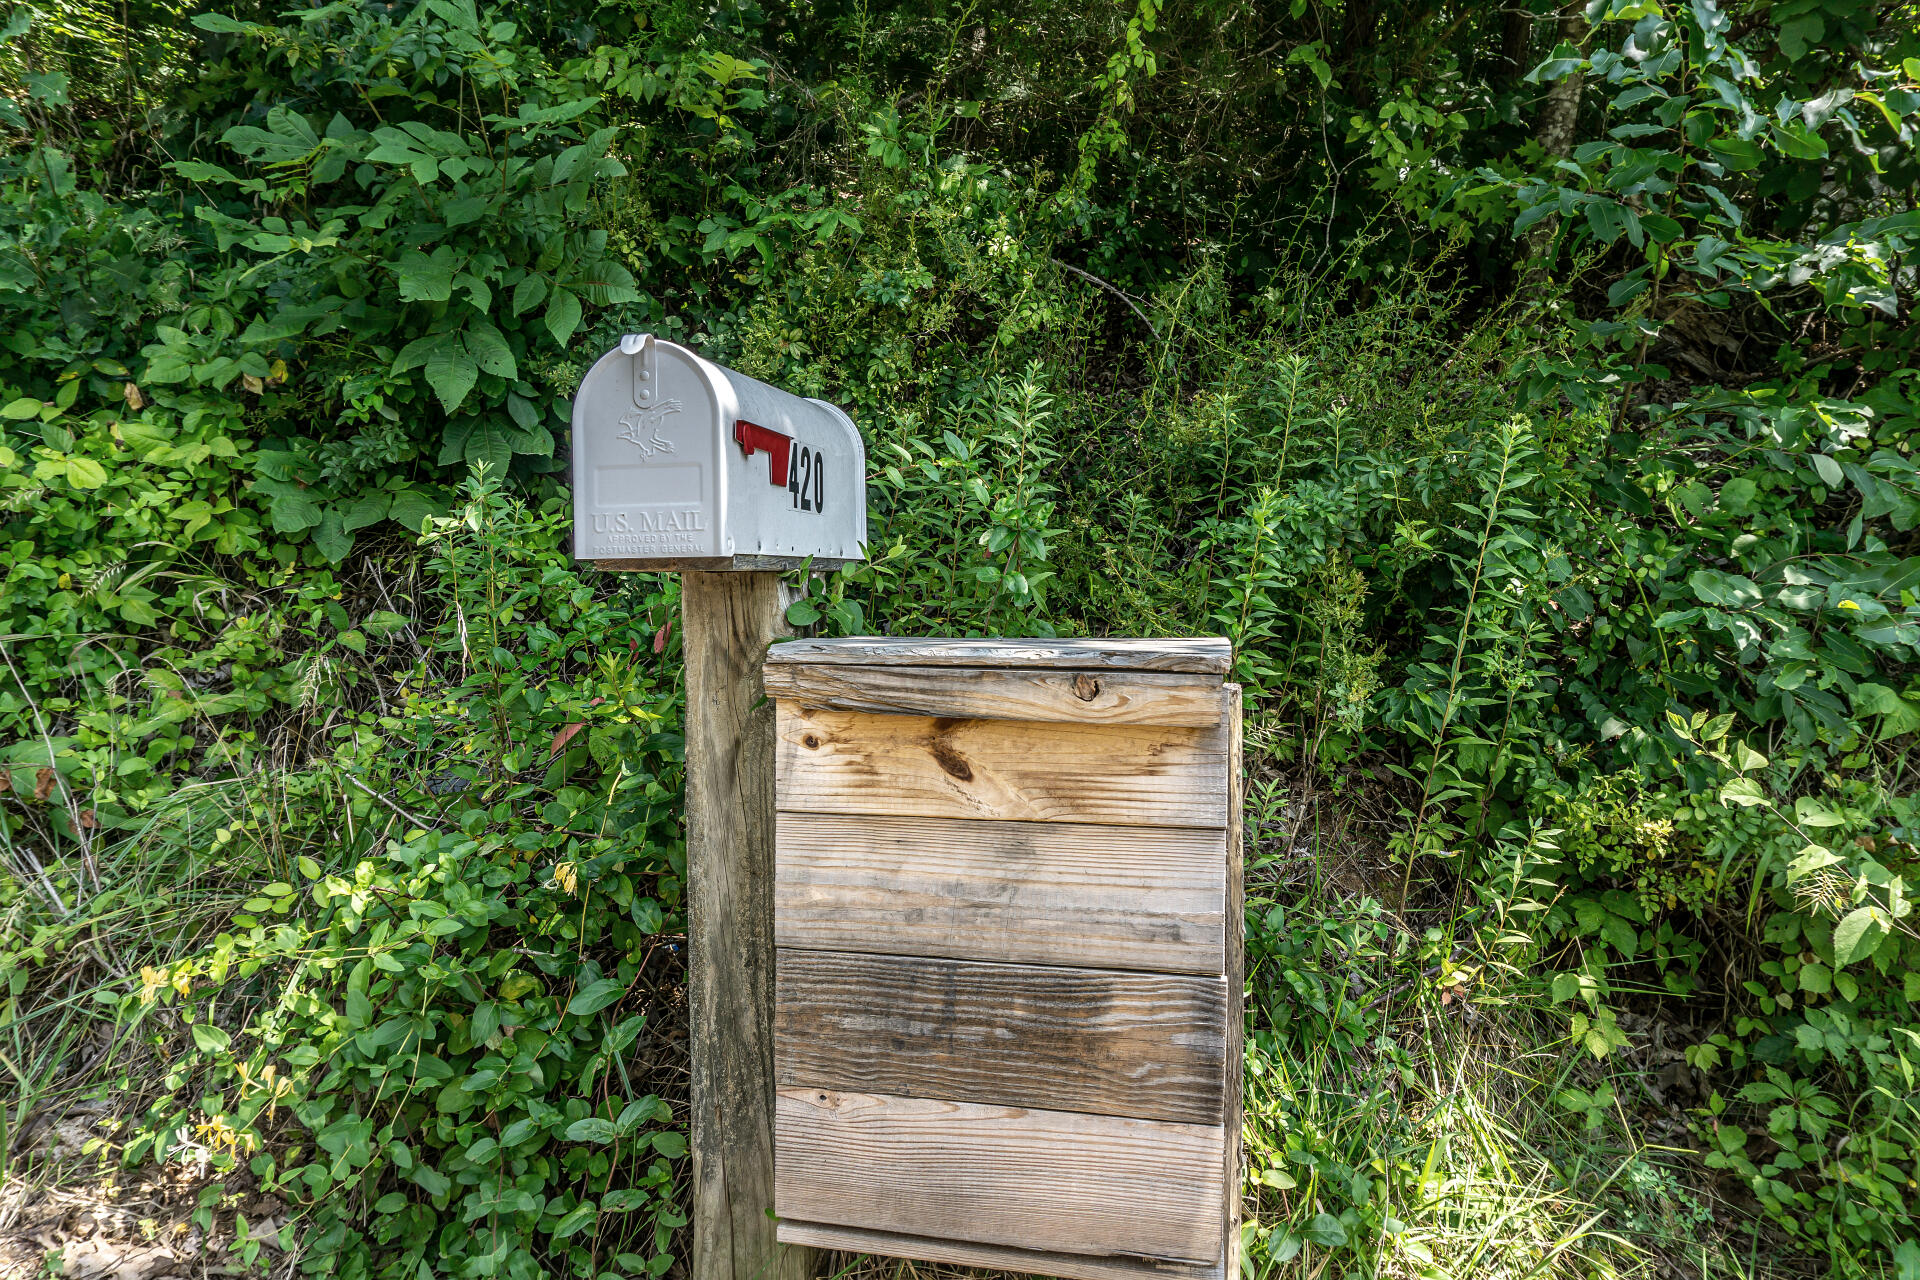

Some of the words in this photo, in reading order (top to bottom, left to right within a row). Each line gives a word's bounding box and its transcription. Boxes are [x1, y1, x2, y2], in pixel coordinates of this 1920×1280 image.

[789, 443, 823, 513] 420
[592, 512, 634, 534] U.S.
[640, 510, 706, 532] MAIL
[607, 534, 656, 544] APPROVED
[660, 533, 672, 543] BY
[675, 533, 694, 542] THE
[593, 545, 656, 555] POSTMASTER
[661, 544, 705, 554] GENERAL
